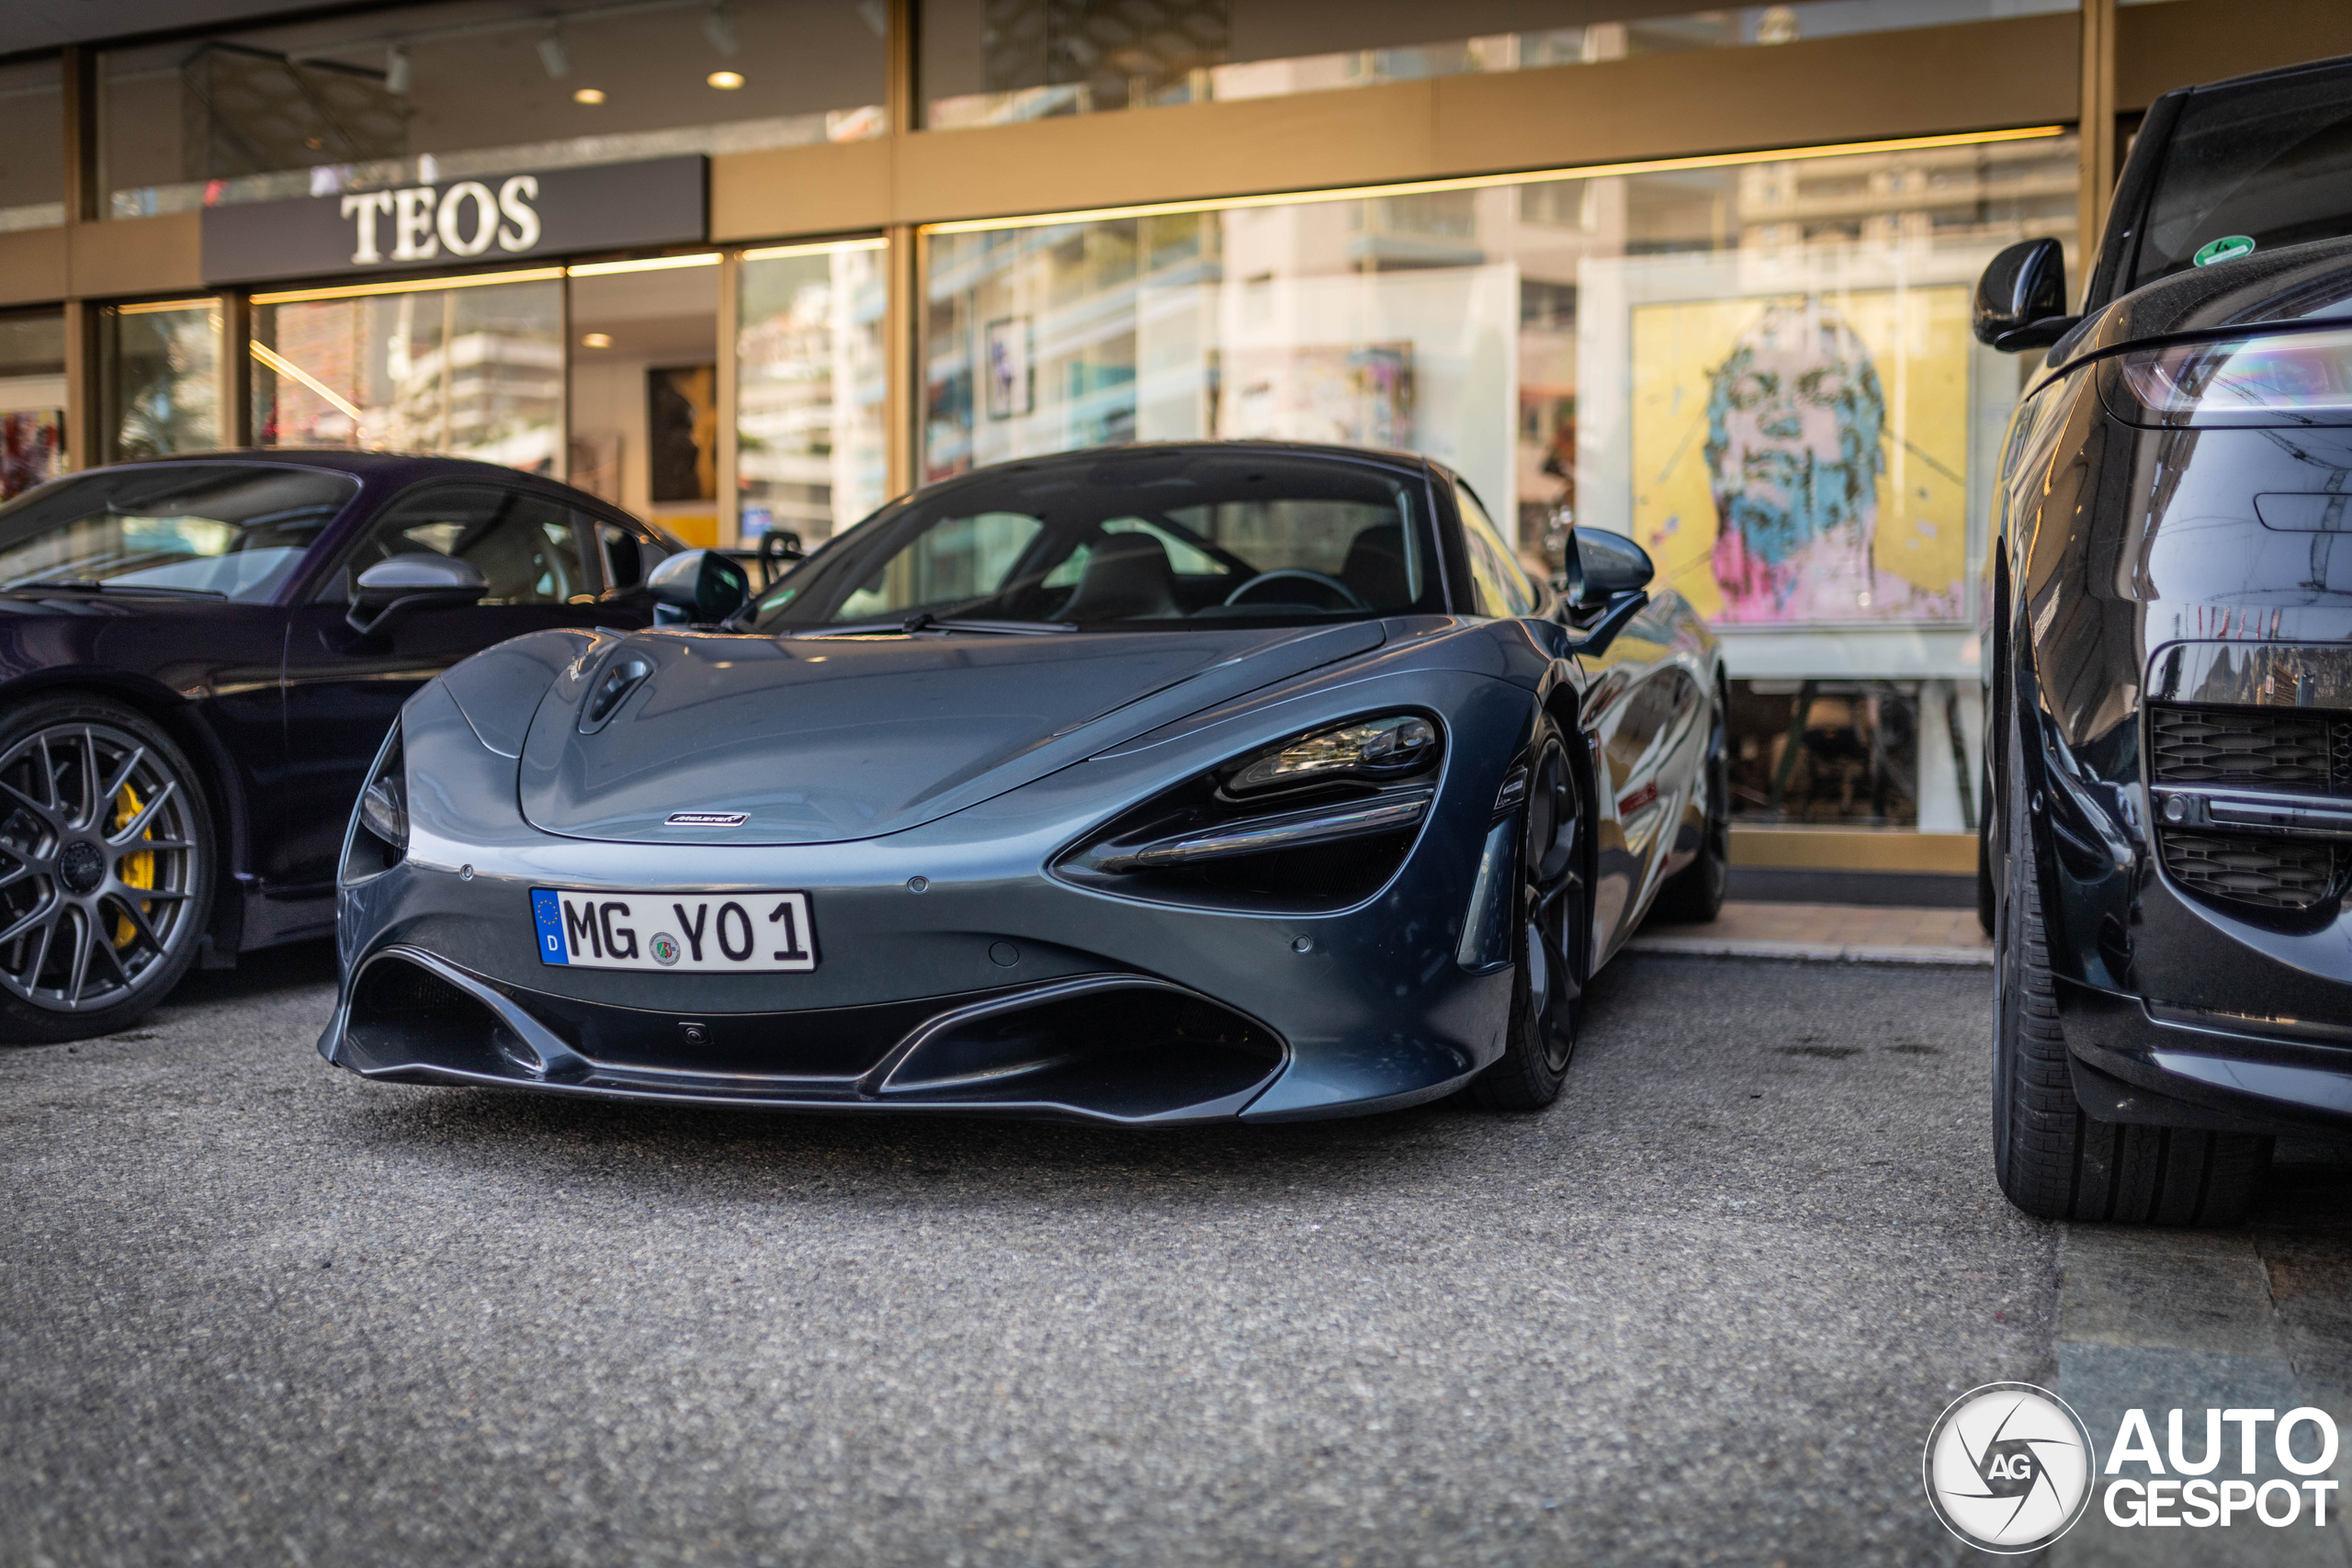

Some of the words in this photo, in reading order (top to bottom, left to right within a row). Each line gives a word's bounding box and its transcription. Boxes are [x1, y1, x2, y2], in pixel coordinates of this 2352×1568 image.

[340, 175, 541, 265] TEOS
[547, 935, 559, 952] D
[563, 899, 639, 959] MG
